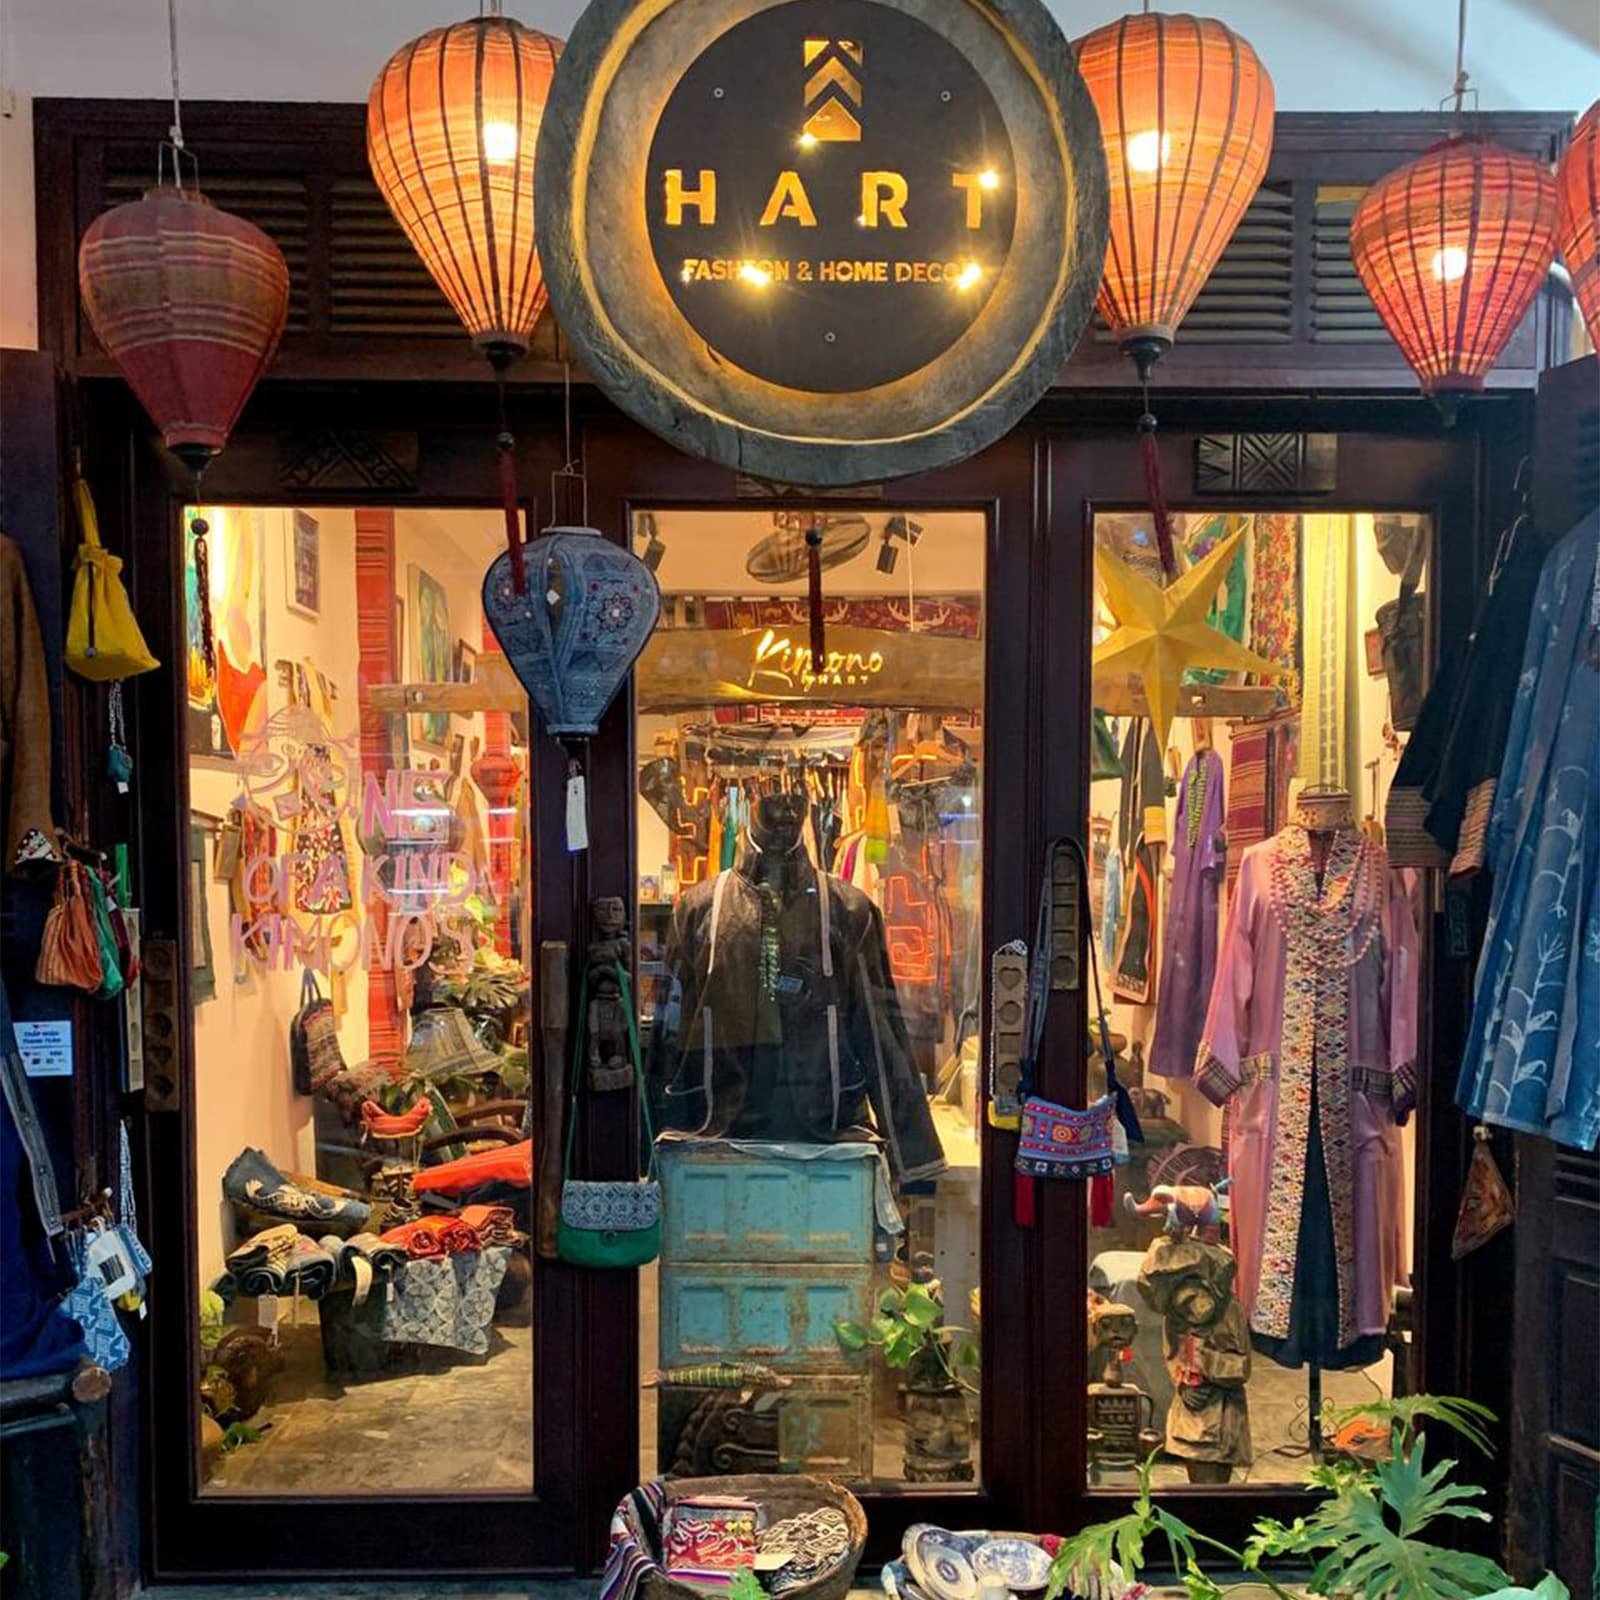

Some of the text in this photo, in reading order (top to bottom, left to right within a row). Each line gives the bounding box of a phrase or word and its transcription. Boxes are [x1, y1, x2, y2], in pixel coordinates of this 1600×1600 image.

[665, 169, 994, 229] HART
[682, 259, 984, 282] FASHON & HOME DECO
[362, 852, 477, 904] KIND
[231, 911, 476, 974] KIMONOS
